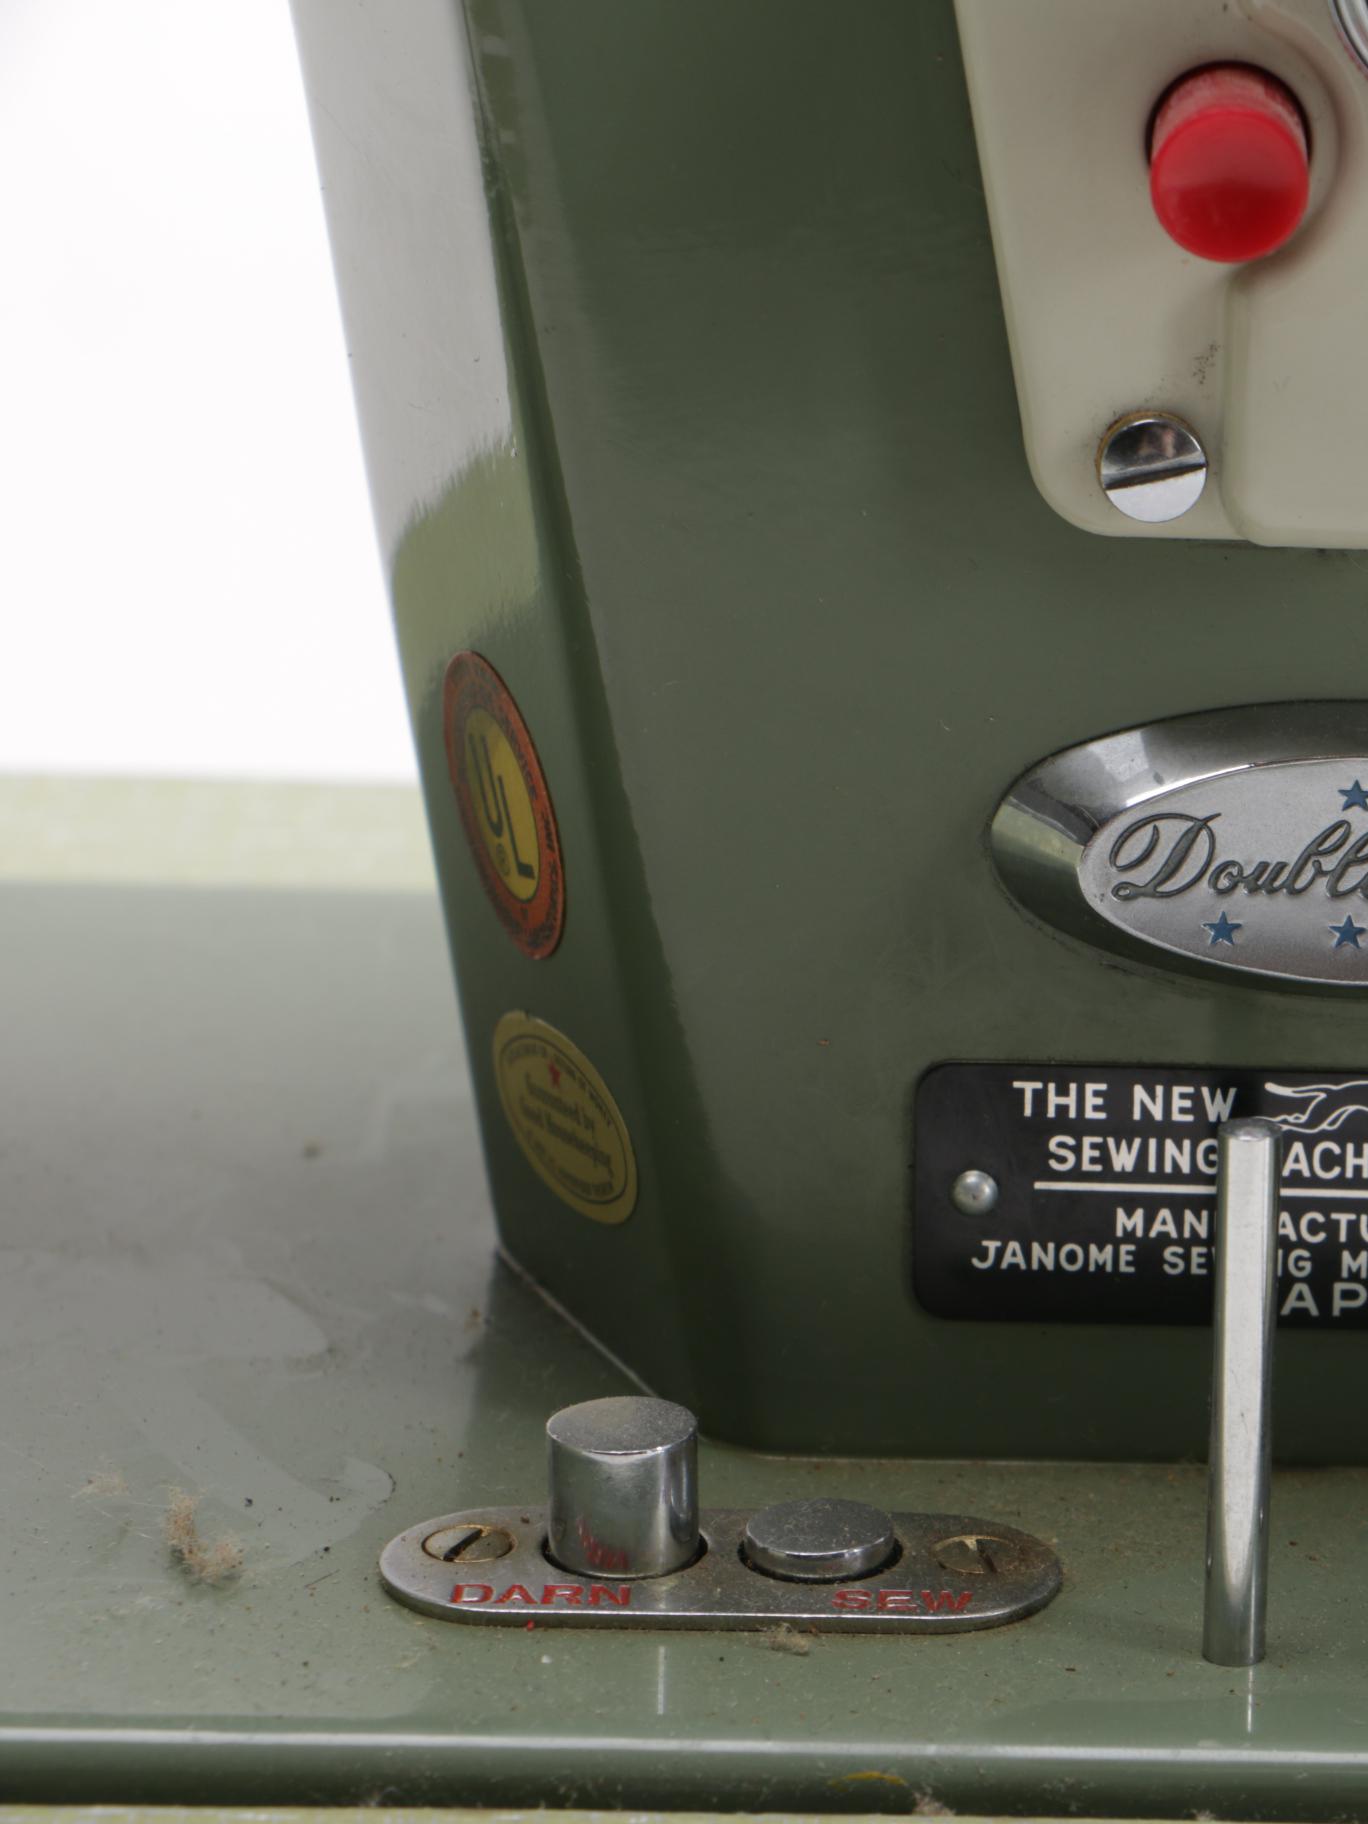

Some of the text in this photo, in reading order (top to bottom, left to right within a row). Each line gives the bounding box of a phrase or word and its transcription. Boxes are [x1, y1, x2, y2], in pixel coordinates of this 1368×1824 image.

[1013, 1081, 1108, 1119] THE
[1132, 1084, 1238, 1122] NEW
[1047, 1135, 1218, 1174] SEWING
[971, 1240, 1136, 1272] JANOME
[1162, 1246, 1313, 1278] SEG
[450, 1583, 632, 1607] DARN
[831, 1588, 973, 1613] SEW
